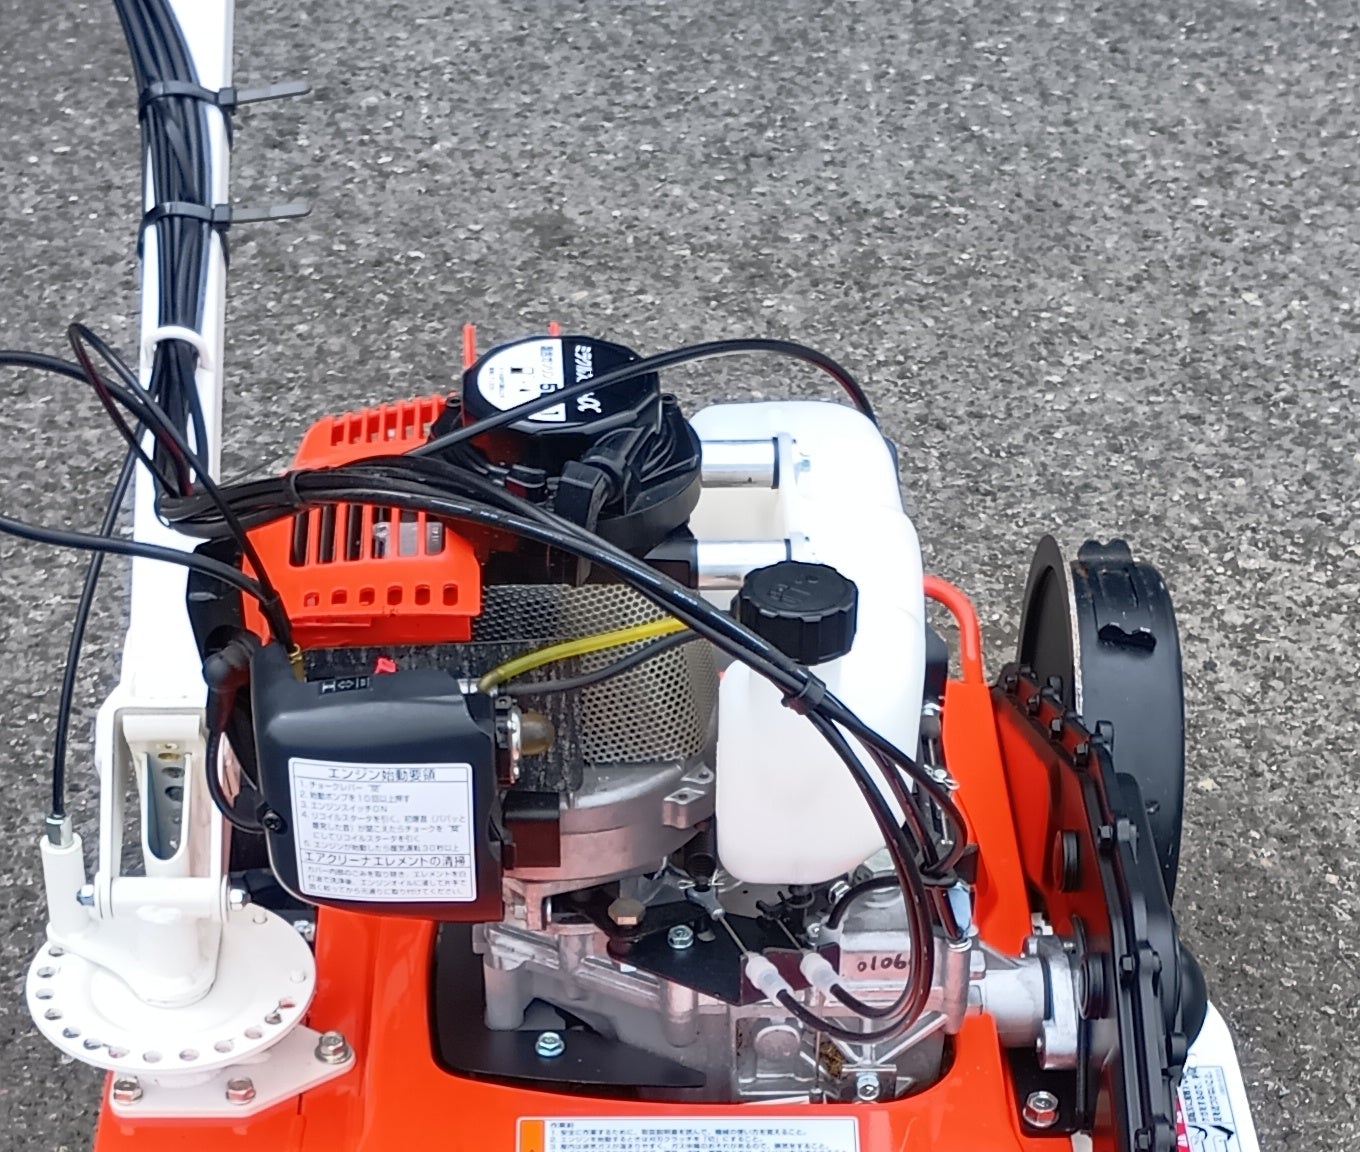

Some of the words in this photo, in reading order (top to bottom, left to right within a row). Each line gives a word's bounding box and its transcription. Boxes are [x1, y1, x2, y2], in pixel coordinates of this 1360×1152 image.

[328, 768, 436, 783] エンジン始動要領
[305, 851, 466, 868] エアクリーナエレメントの清掃
